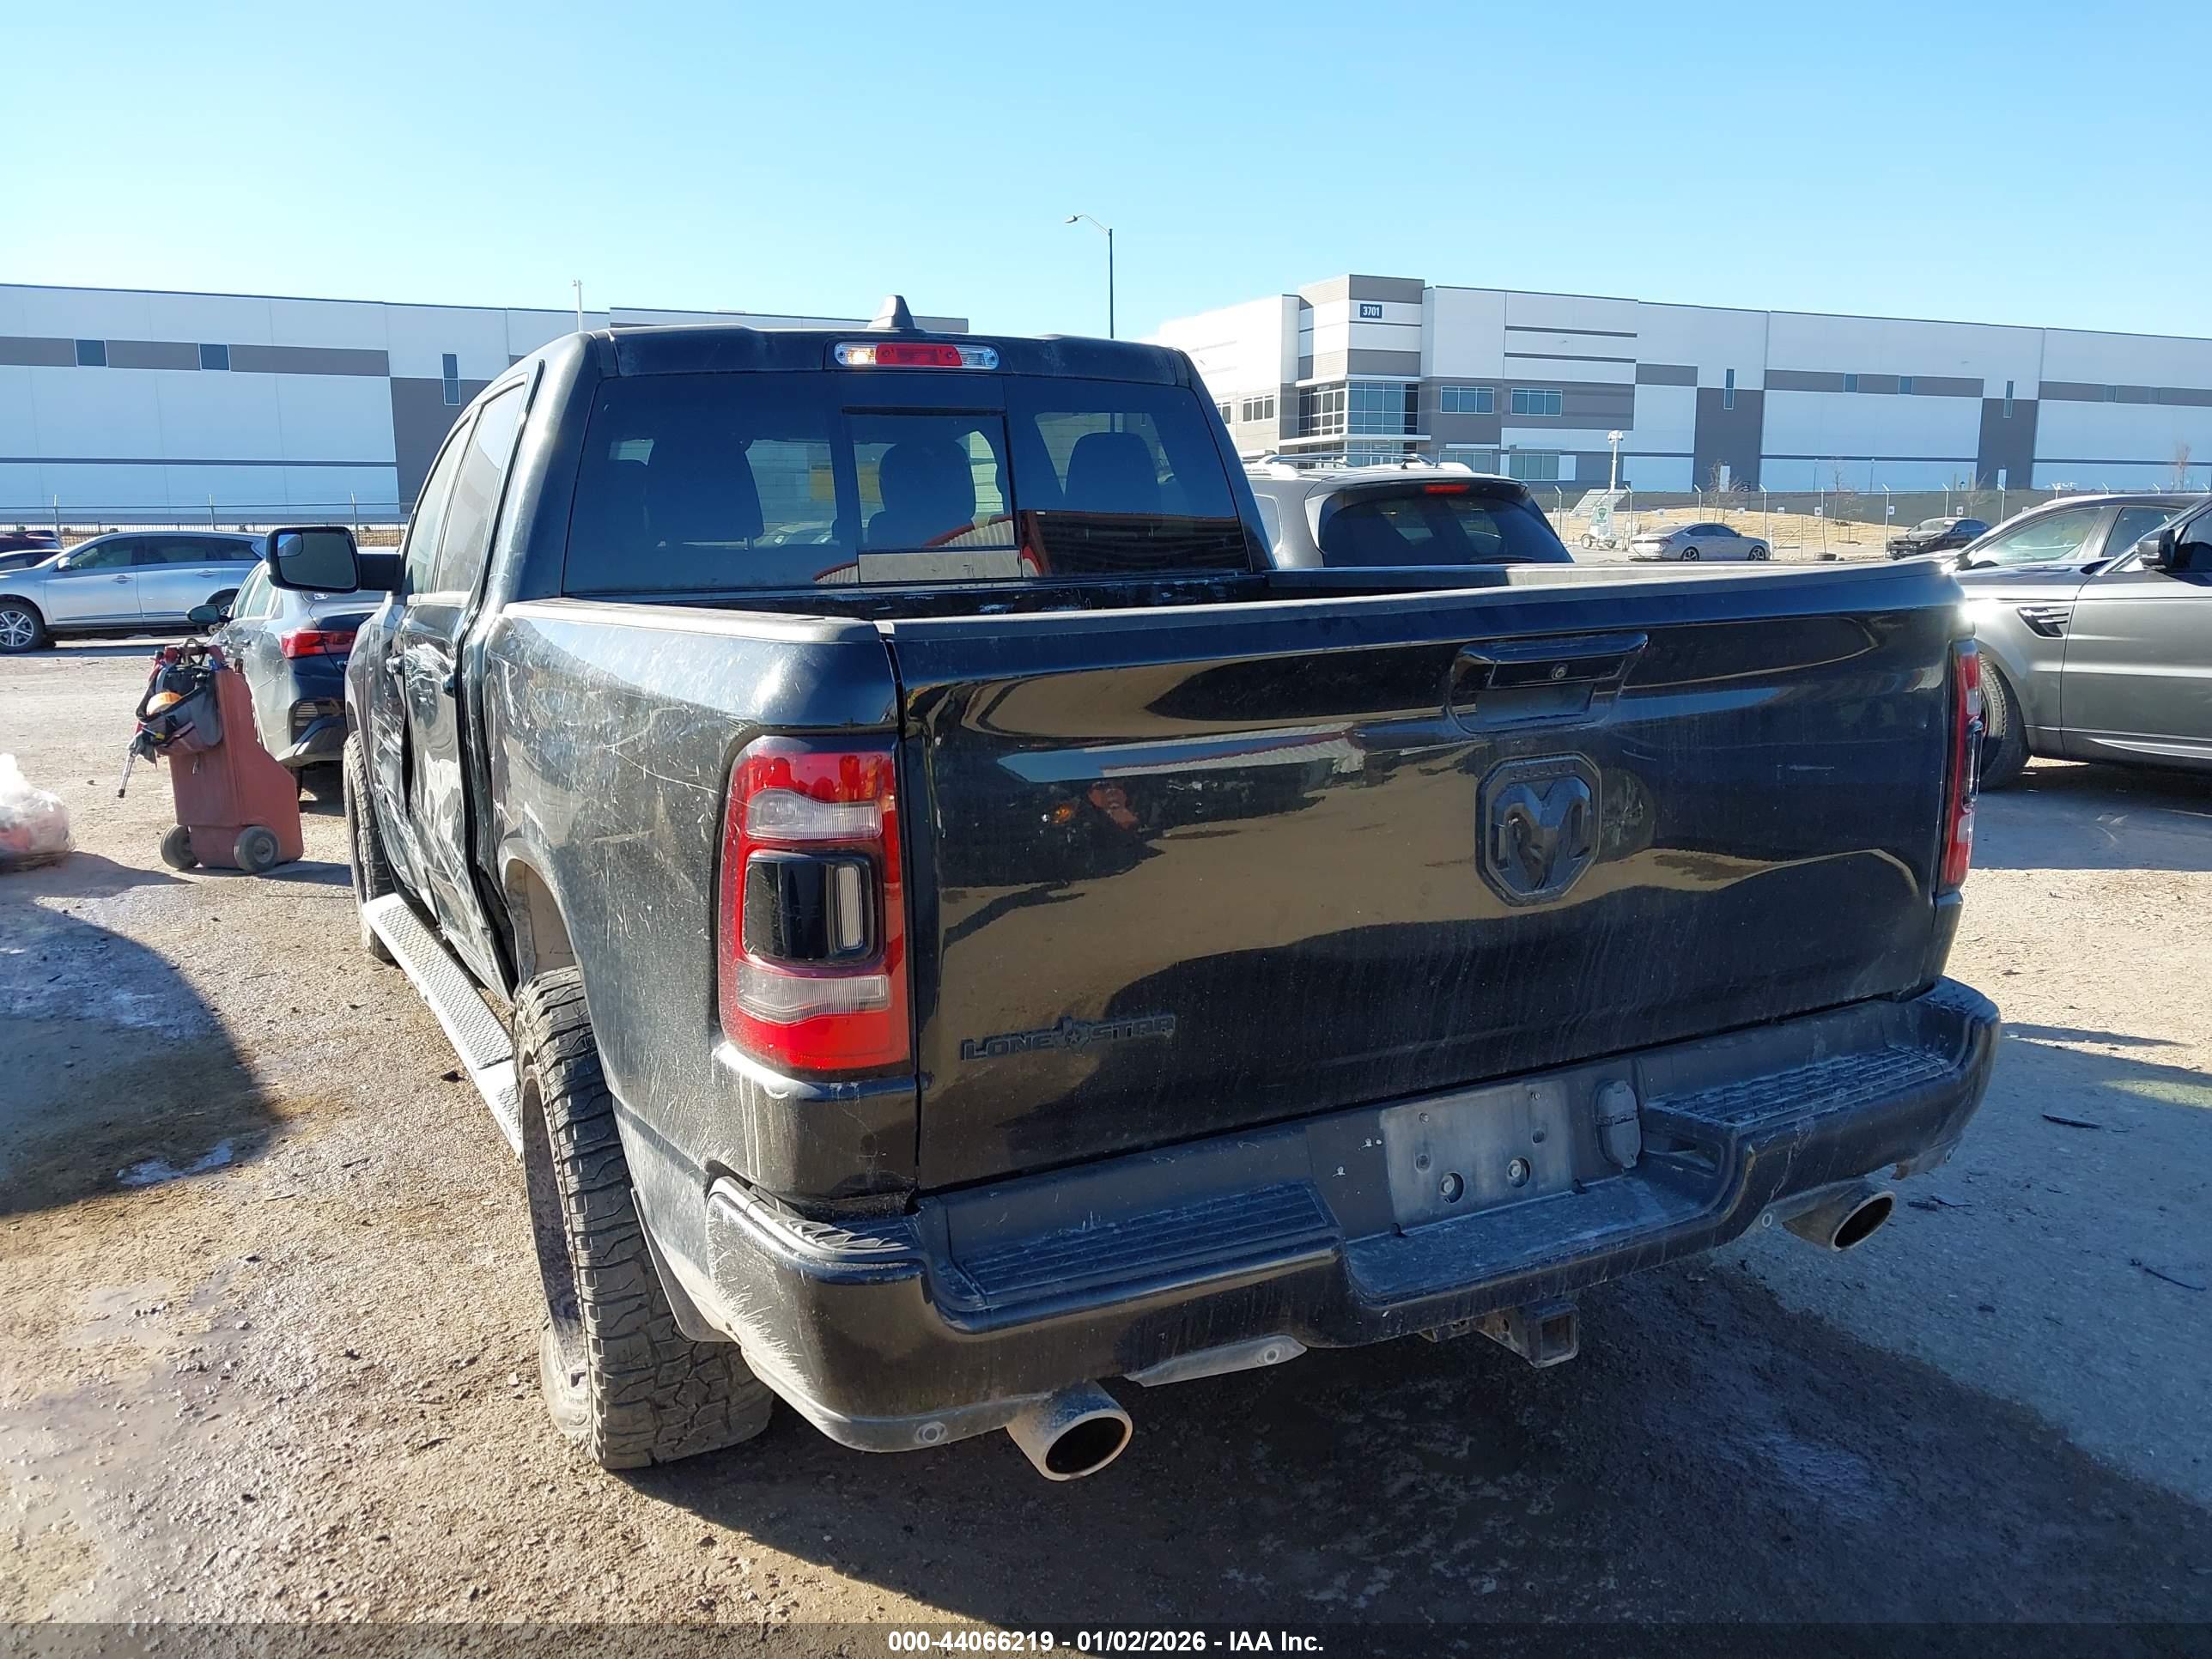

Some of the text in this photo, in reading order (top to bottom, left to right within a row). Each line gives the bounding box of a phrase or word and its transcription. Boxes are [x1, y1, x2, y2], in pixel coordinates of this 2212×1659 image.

[1363, 306, 1380, 317] 3701
[961, 1015, 1176, 1061] LONE STAR
